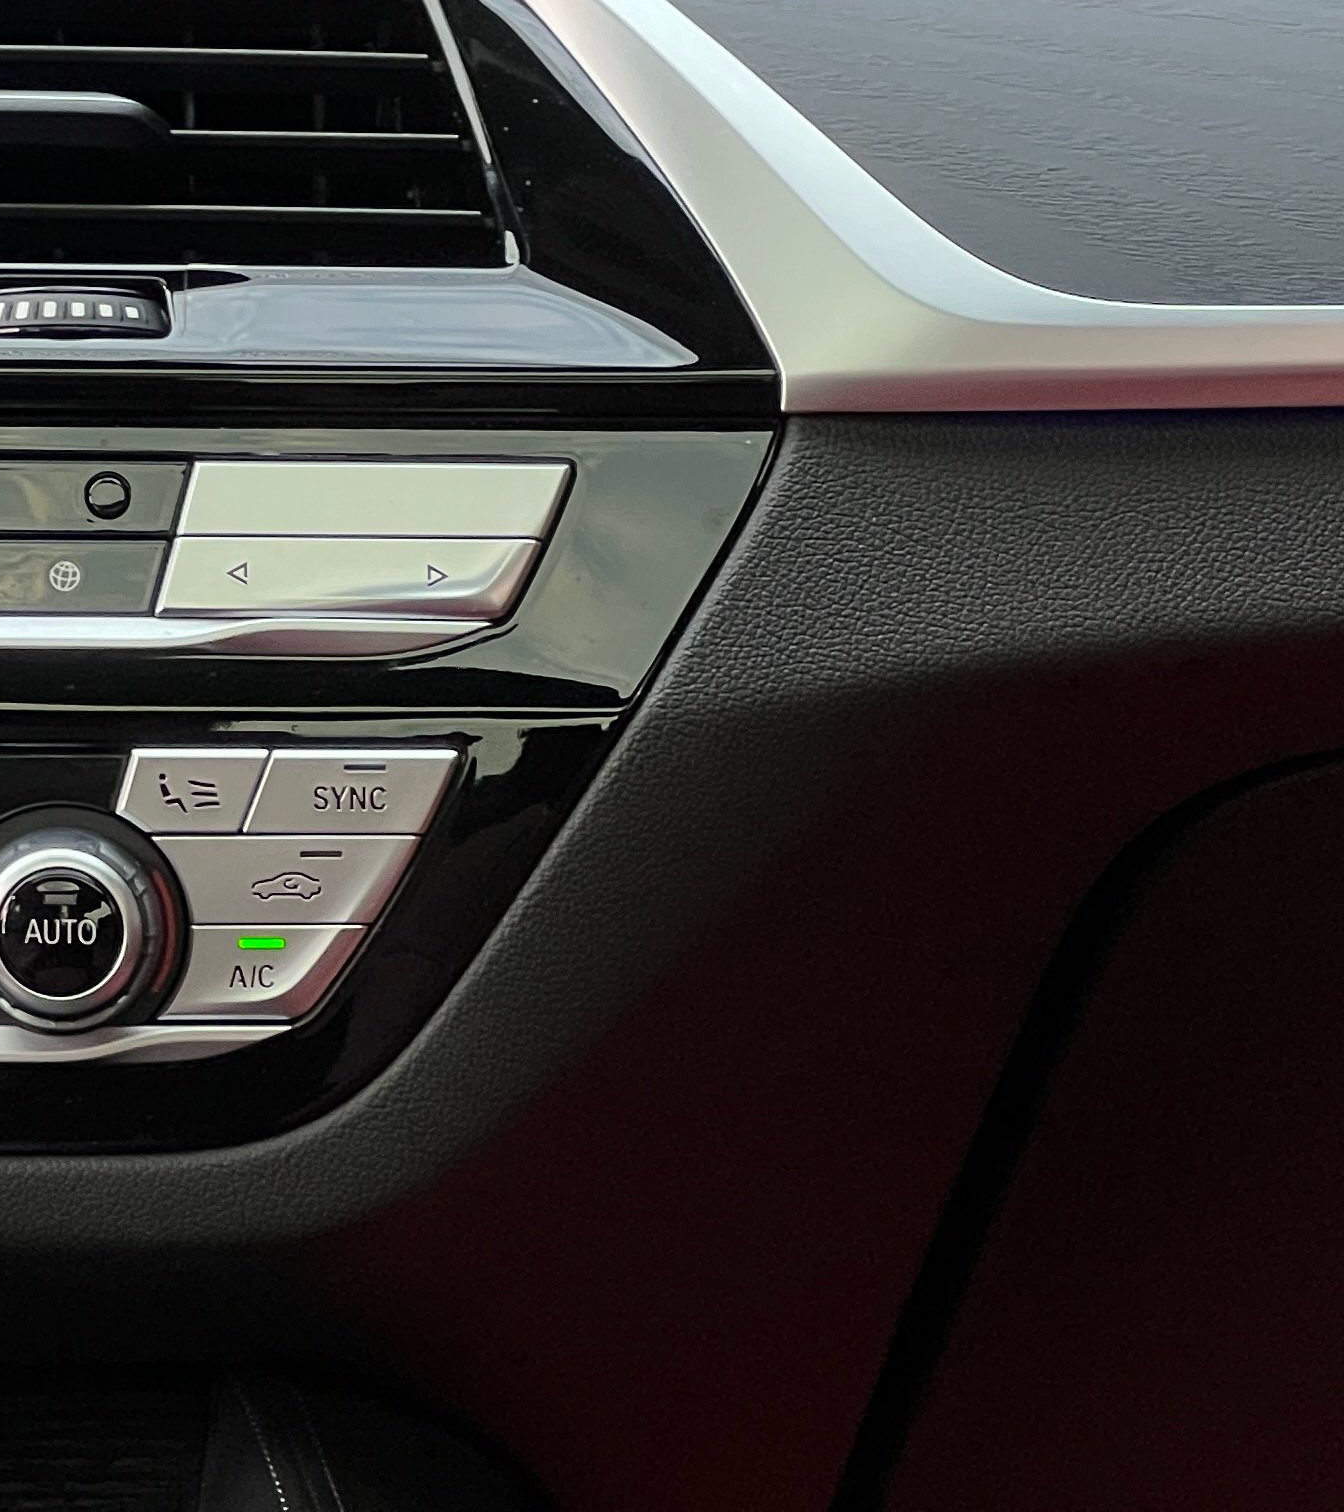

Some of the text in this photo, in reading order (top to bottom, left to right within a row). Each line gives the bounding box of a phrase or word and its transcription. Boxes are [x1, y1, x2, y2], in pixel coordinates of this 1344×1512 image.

[313, 786, 388, 811] SYNC
[24, 918, 98, 946] AUTO
[229, 965, 276, 989] A/C
